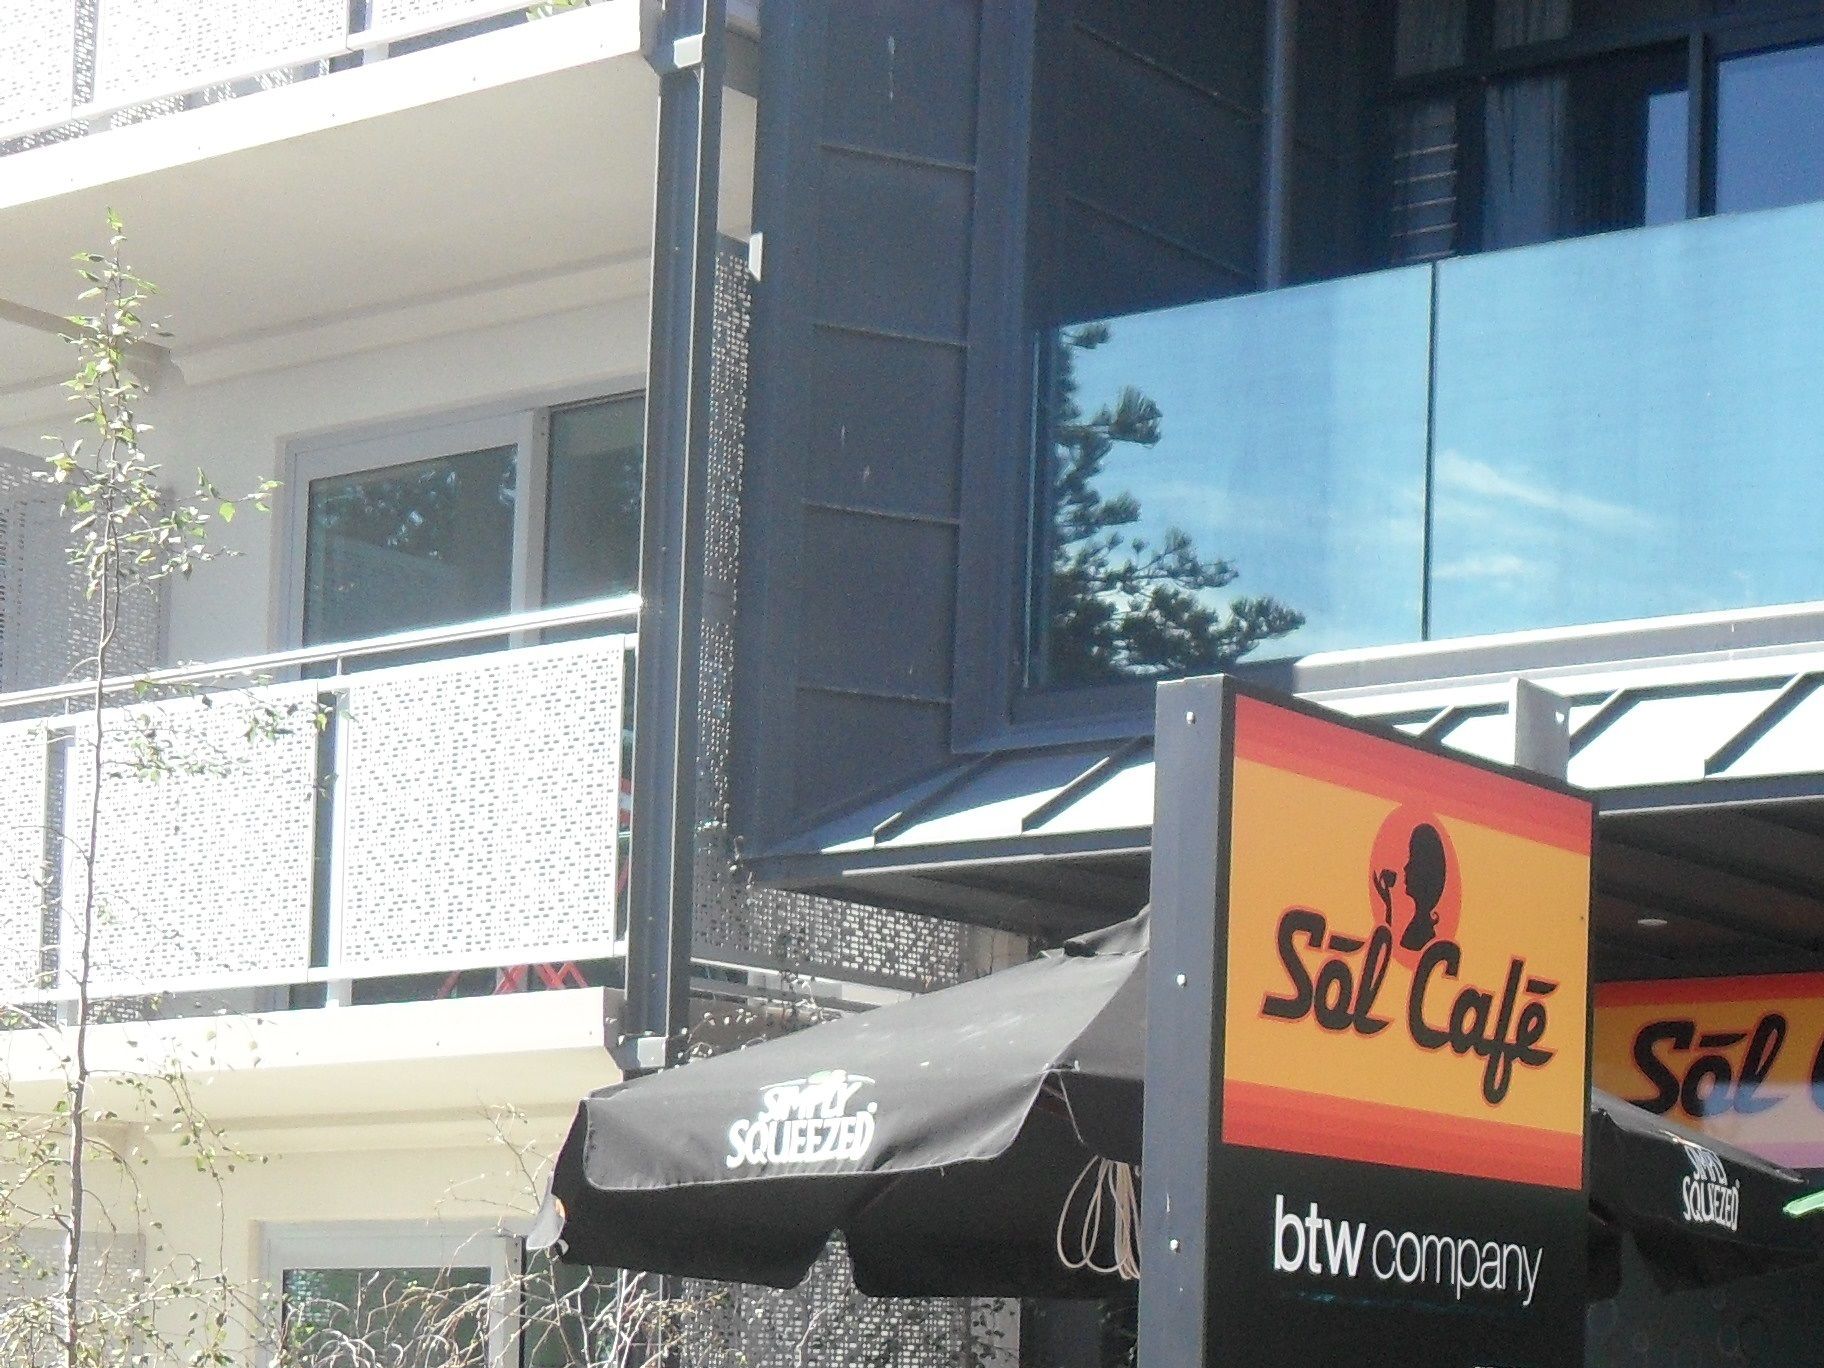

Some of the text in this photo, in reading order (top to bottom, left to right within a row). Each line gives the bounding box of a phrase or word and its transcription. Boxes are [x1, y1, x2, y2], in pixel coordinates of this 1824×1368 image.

[726, 1111, 876, 1169] SQUEEZED
[1273, 1194, 1543, 1305] btw company
